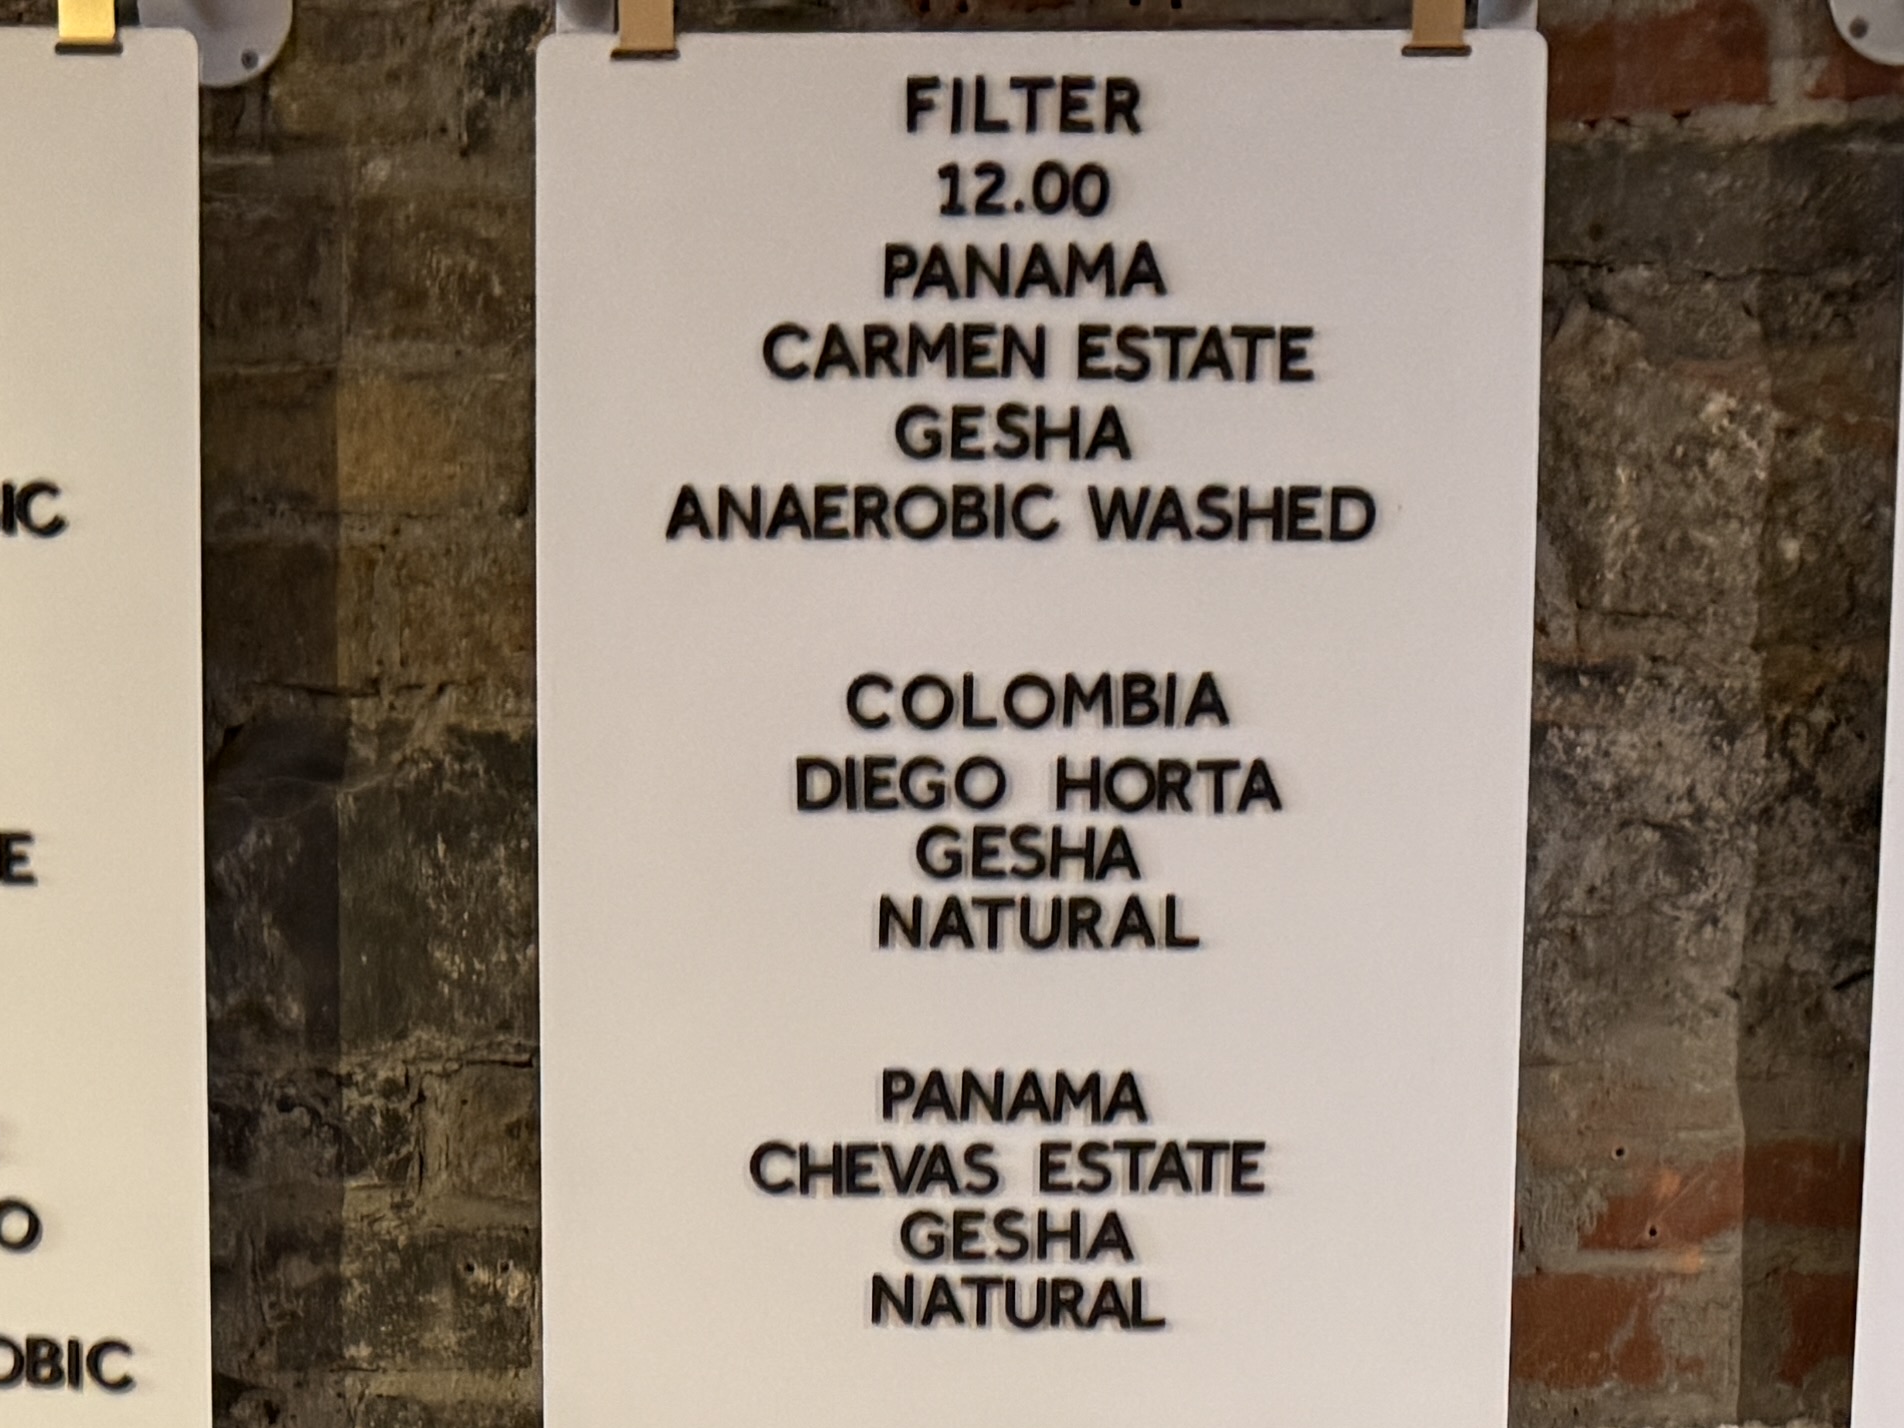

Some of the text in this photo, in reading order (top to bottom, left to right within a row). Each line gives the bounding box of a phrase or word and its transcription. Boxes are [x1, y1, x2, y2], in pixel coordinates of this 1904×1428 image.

[905, 74, 1143, 136] FILTER
[937, 159, 1112, 219] 12.00
[883, 240, 1168, 301] PANAMA
[762, 322, 1315, 384] CARMEN ESTATE
[894, 402, 1133, 462] GESHA
[665, 482, 1377, 543] ANAEROBIC WASHED
[846, 671, 1231, 732] COLOMBIA
[796, 755, 1283, 815] DIEGO HORTA
[915, 823, 1142, 882] GESHA
[878, 893, 1200, 951] NATURAL
[882, 1068, 1149, 1125] PANAMA
[749, 1139, 1266, 1197] CHEVAS ESTATE
[899, 1208, 1135, 1263] GESHA
[871, 1273, 1167, 1331] NATURAL
